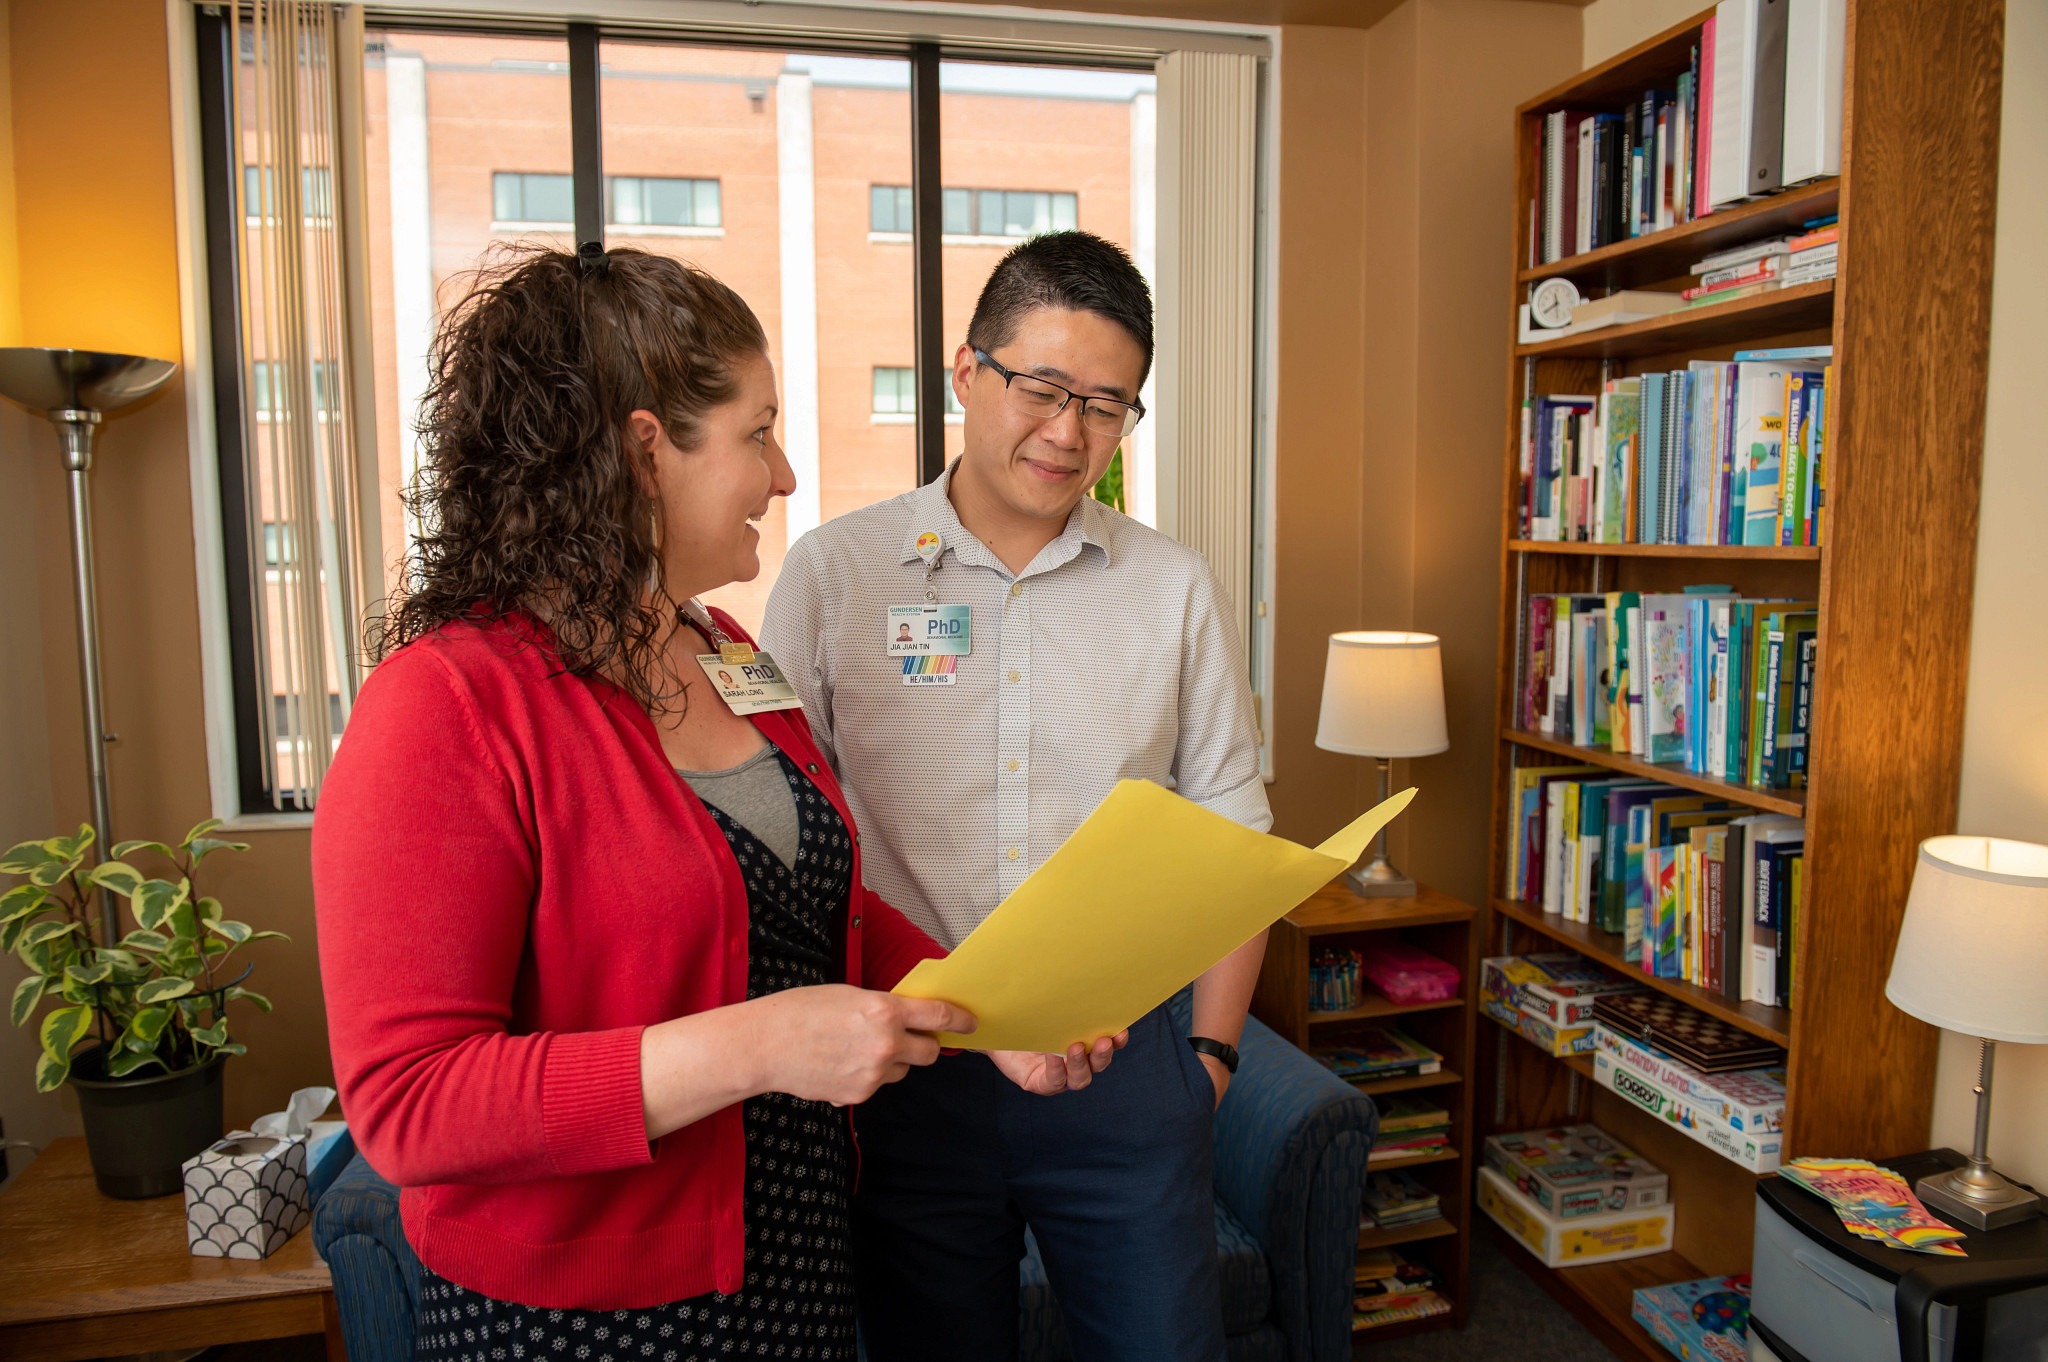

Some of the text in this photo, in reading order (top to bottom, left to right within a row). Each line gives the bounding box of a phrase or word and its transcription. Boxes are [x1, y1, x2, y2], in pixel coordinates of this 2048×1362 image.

[1785, 397, 1800, 518] TALKING BACK TO OCD
[928, 619, 961, 635] PhD
[741, 664, 775, 680] PhD
[910, 674, 949, 684] HE/HIM/HIS
[722, 688, 764, 698] SARAH LONG
[1759, 859, 1771, 923] BIOFEEDBACK
[1519, 987, 1551, 1014] CONNECT
[1625, 1047, 1660, 1077] CANDY
[1661, 1067, 1690, 1095] LAND
[1616, 1072, 1660, 1109] SORRY!
[1810, 1177, 1878, 1194] Prism
